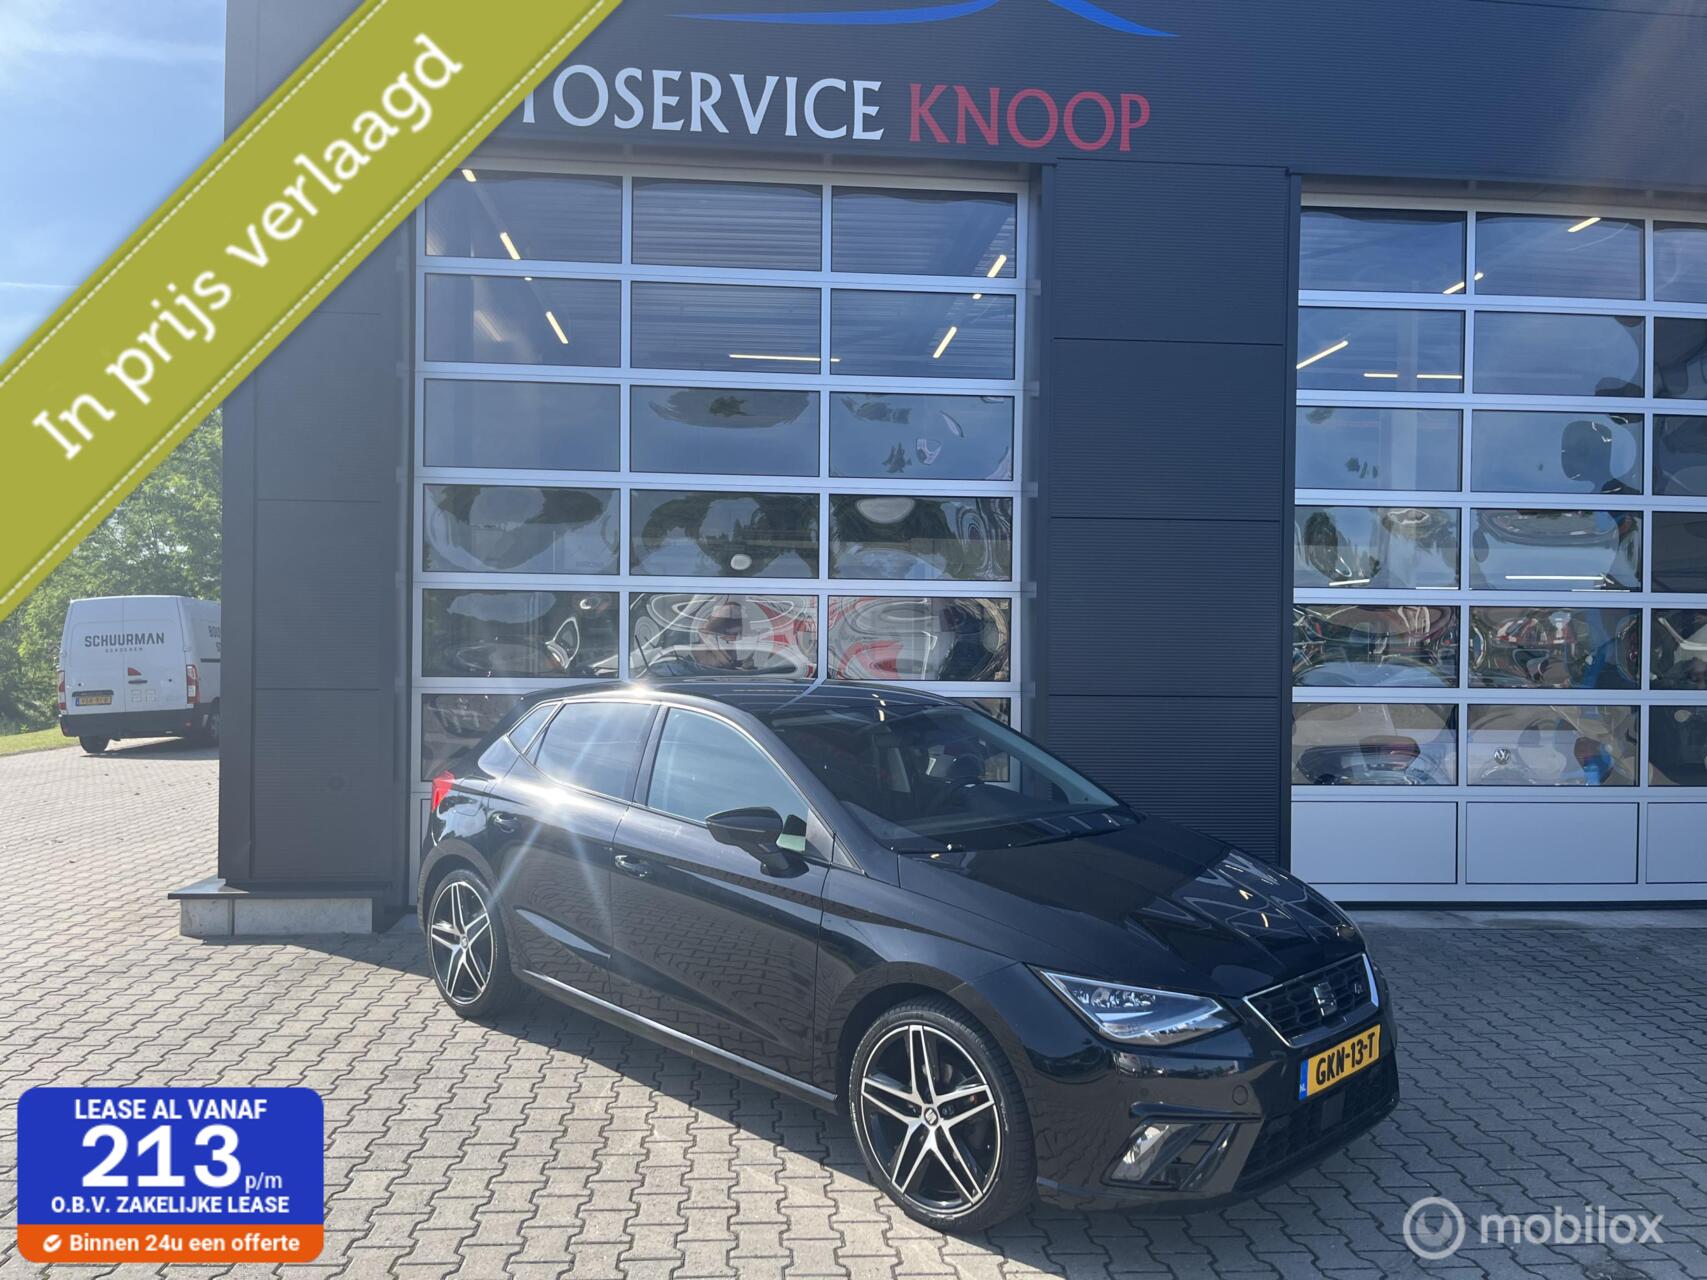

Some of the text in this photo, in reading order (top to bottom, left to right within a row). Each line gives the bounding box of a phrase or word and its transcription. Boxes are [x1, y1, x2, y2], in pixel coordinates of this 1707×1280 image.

[908, 83, 1151, 152] KNOOP
[84, 632, 165, 648] SCHUURMAN
[1316, 1032, 1376, 1086] GKN-13-T
